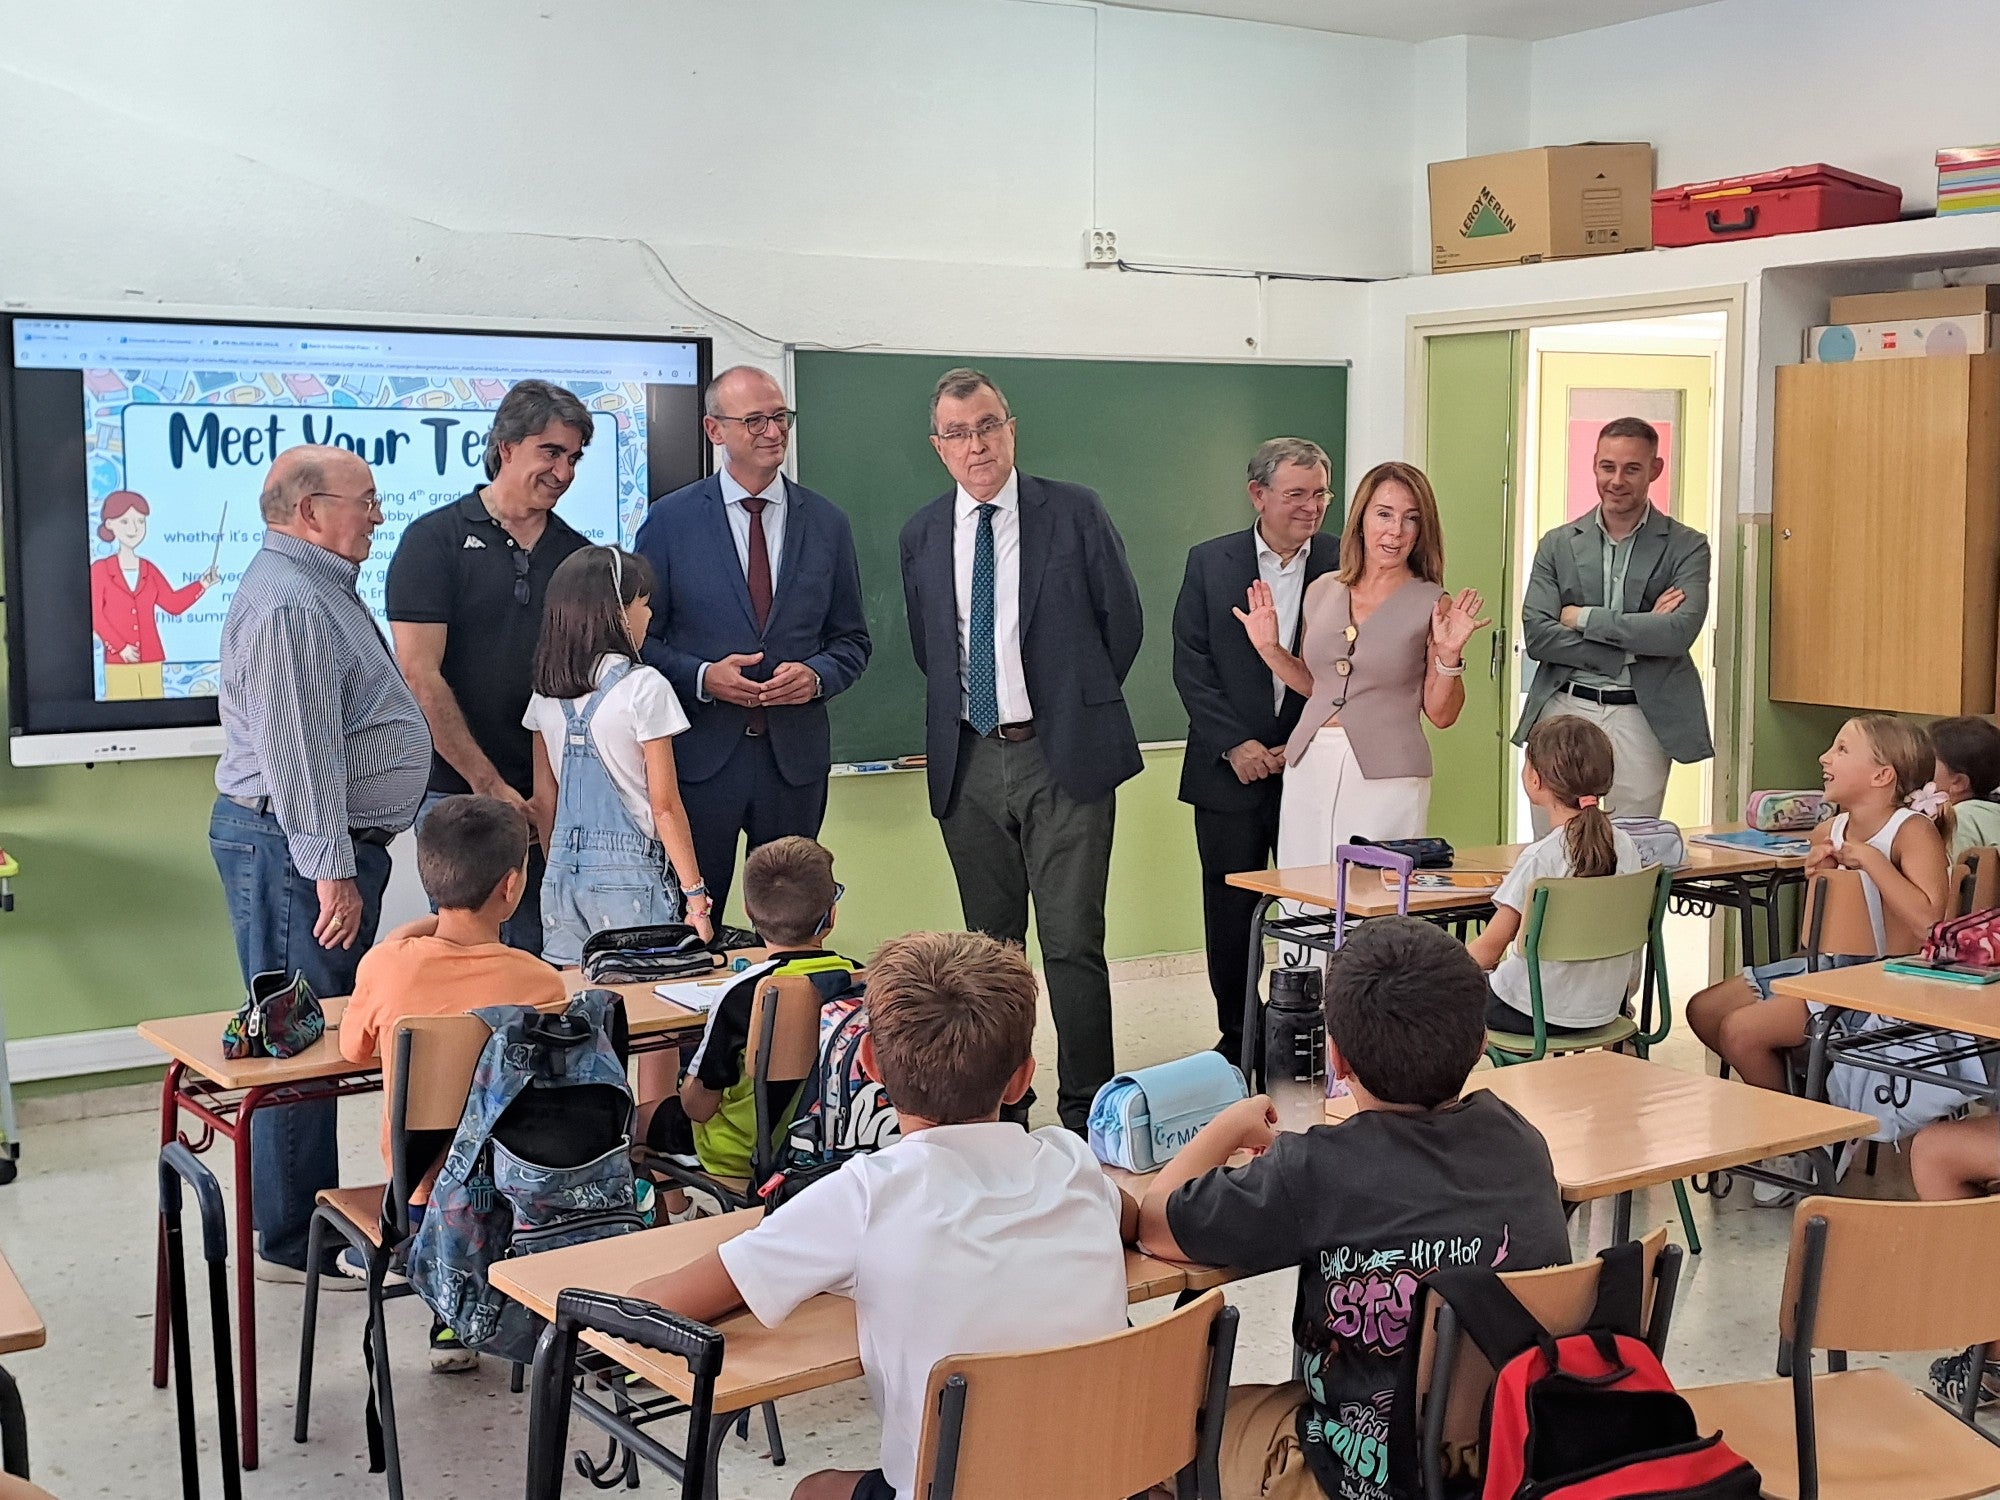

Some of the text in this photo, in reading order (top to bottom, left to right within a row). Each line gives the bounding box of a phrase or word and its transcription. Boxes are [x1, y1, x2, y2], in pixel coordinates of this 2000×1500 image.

[1459, 186, 1517, 237] LEROY MERLIN
[168, 412, 286, 469] Meet
[1409, 1238, 1446, 1269] HIP
